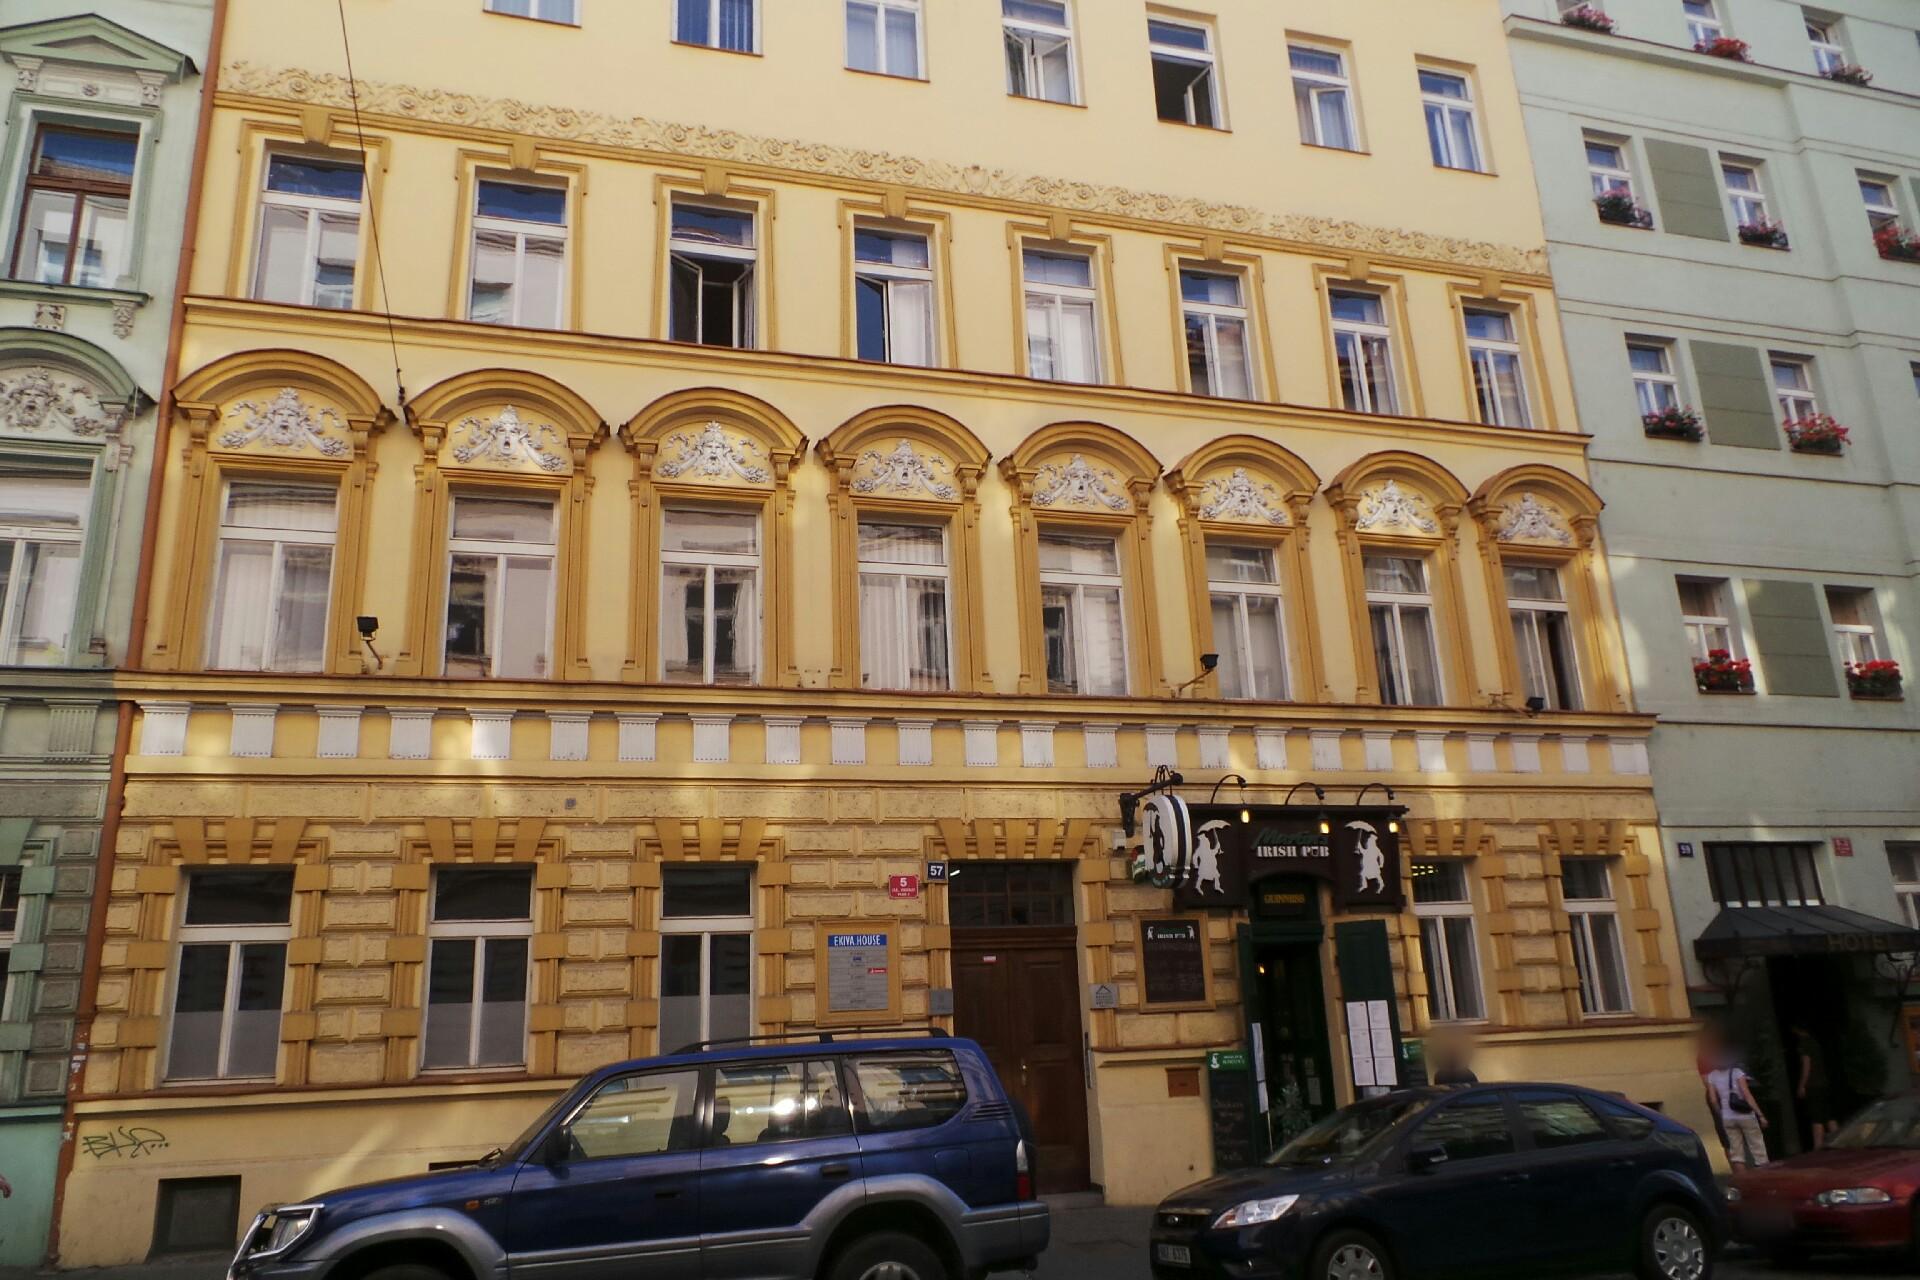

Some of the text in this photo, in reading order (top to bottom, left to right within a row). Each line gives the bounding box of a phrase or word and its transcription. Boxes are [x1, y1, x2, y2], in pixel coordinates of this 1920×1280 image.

[1257, 846, 1329, 857] IRISH PUB
[931, 866, 943, 876] 57
[900, 878, 908, 887] 5
[857, 935, 880, 945] HOUSE
